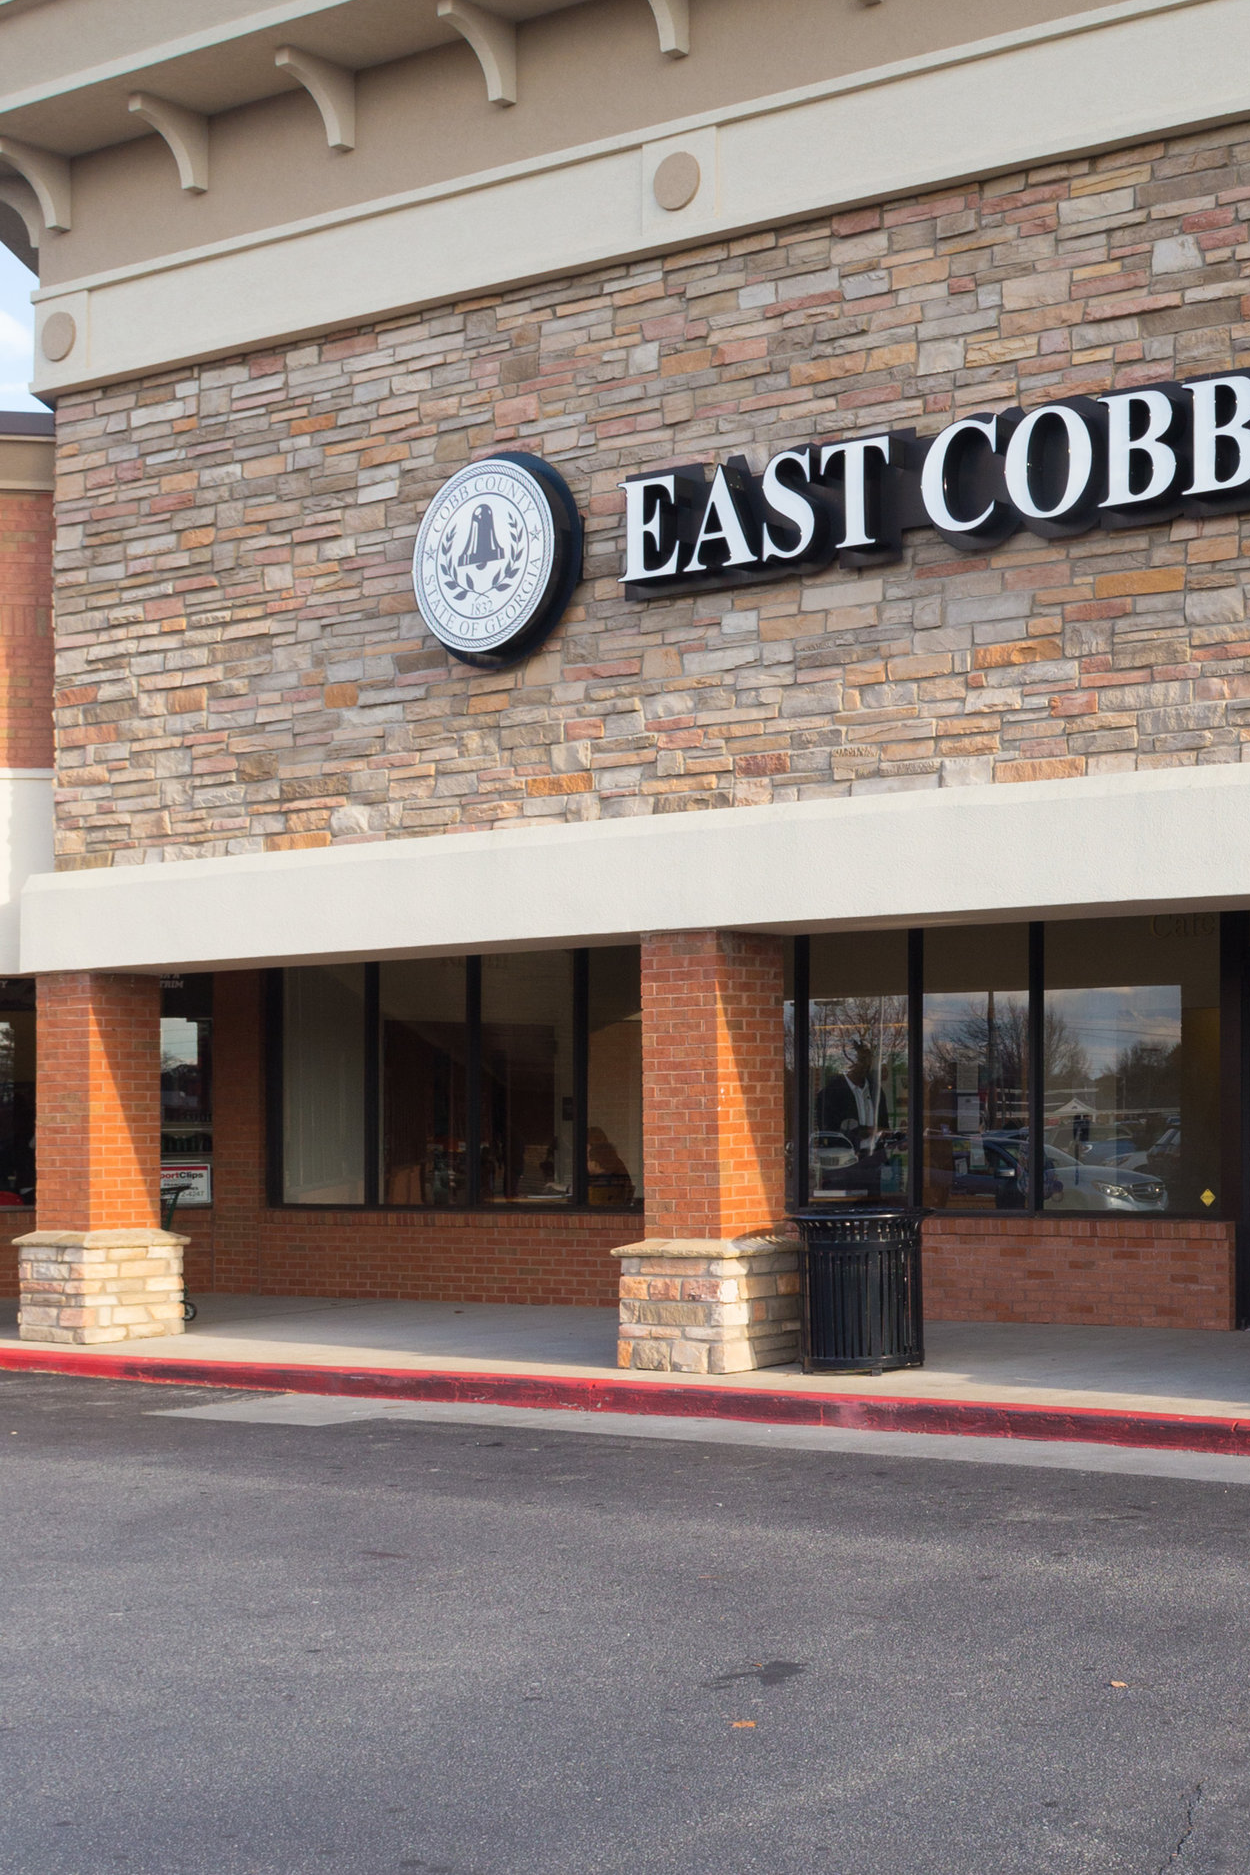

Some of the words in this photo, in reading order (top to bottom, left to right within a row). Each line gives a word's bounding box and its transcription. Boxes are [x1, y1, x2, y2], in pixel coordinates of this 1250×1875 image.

[433, 486, 470, 534] COBB
[474, 476, 536, 515] COUNTY
[617, 434, 890, 583] EAST
[424, 573, 455, 629] STATE
[459, 620, 479, 637] OF
[485, 557, 542, 633] GEORGIA
[470, 600, 494, 616] 1832
